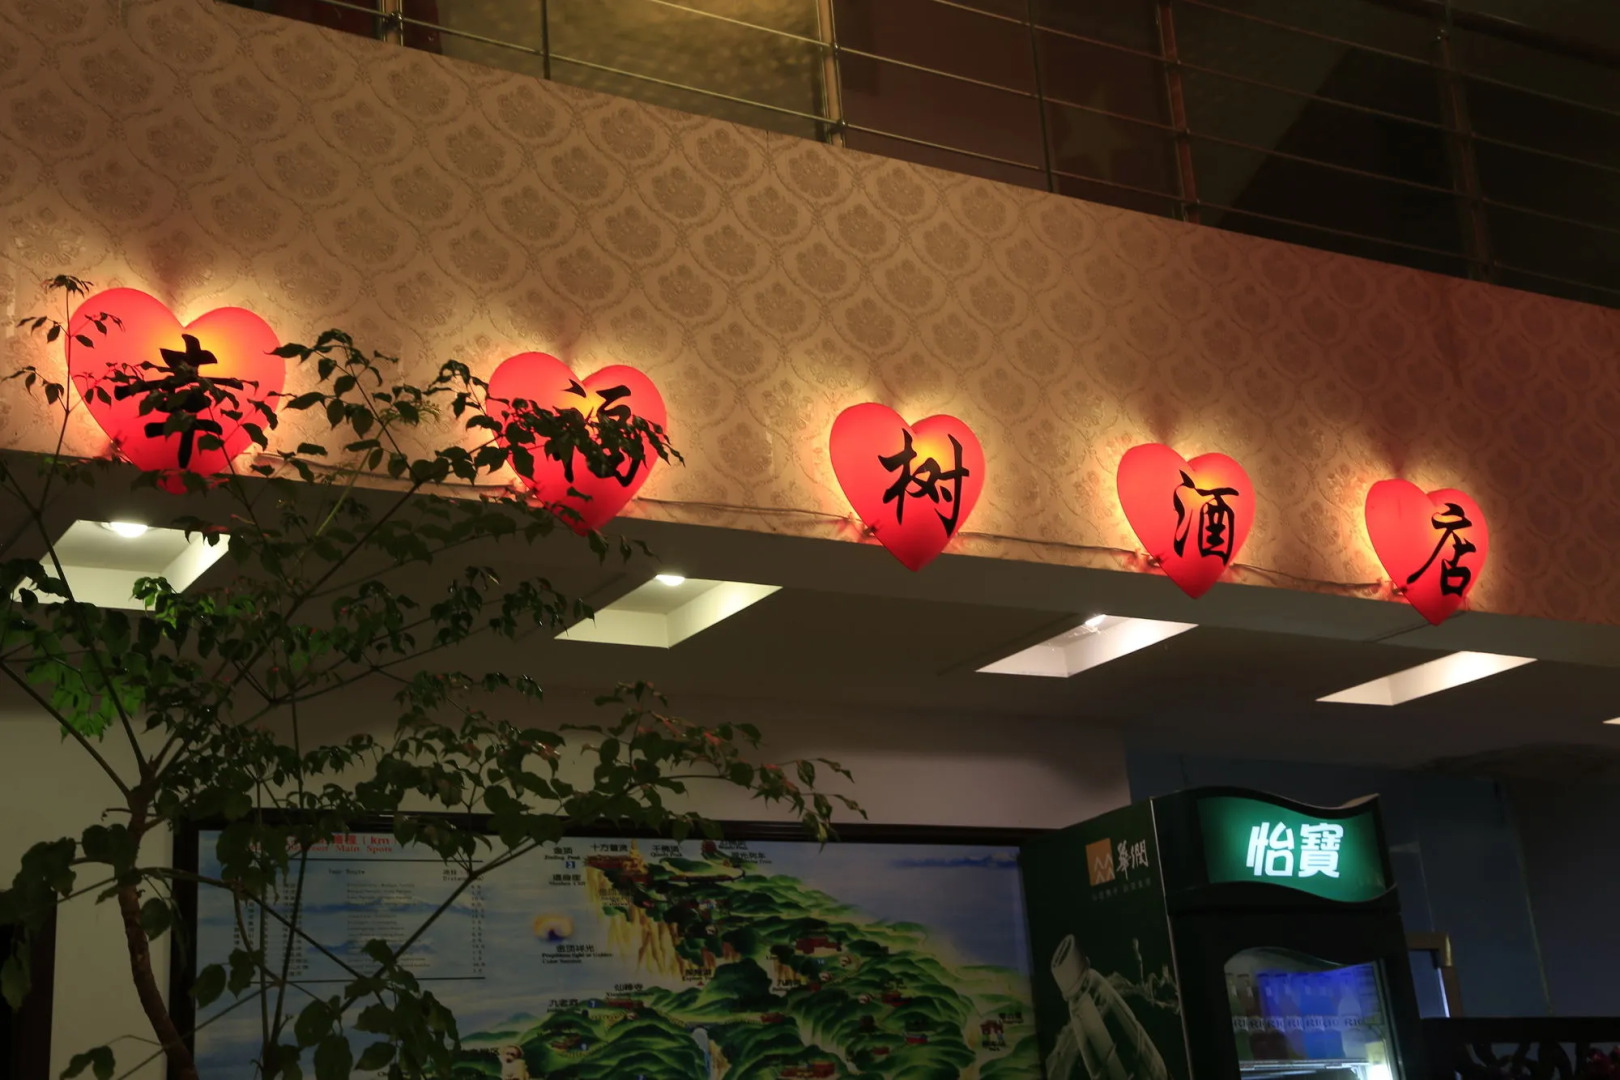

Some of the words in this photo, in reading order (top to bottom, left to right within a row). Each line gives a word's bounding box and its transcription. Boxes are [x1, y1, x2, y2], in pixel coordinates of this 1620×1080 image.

[878, 428, 969, 537] 树
[1173, 470, 1238, 566] 酒
[1407, 503, 1476, 597] 店
[1246, 821, 1343, 878] 怡寶
